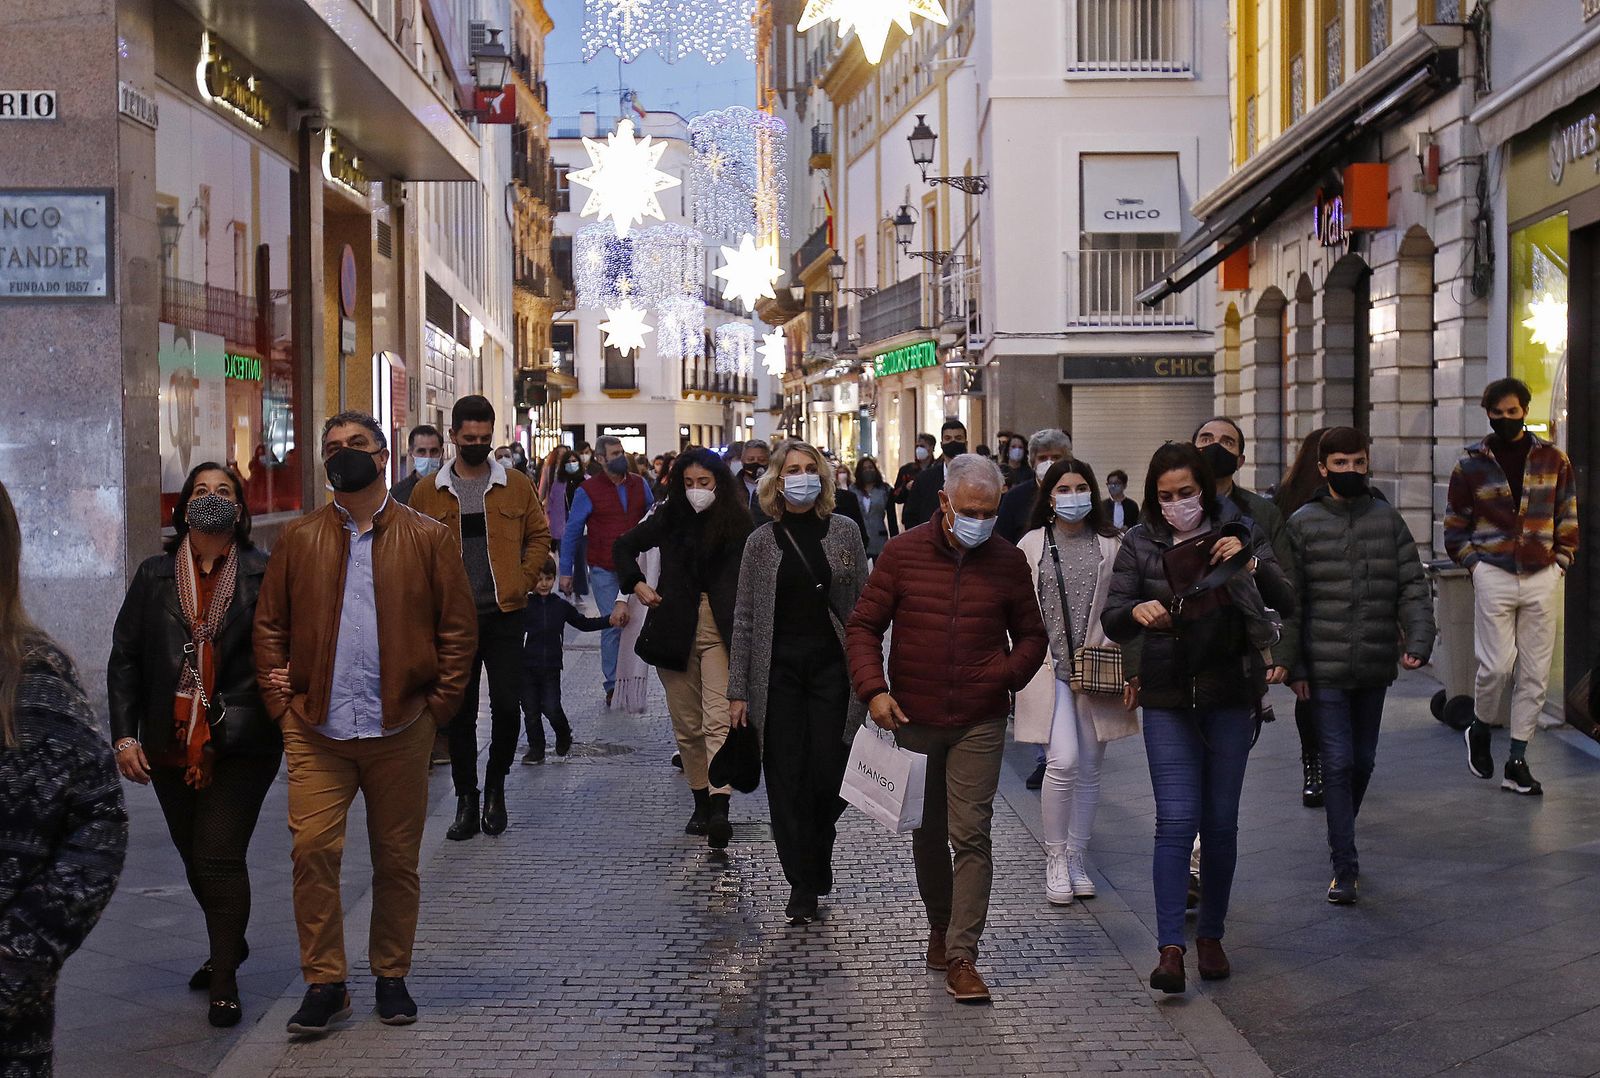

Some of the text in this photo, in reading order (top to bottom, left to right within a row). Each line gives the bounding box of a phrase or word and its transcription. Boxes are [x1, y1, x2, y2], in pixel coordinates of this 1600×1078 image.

[0, 93, 54, 117] RIO
[1562, 112, 1596, 164] YVES
[3, 207, 62, 229] NCO
[1103, 209, 1160, 221] CHICO
[9, 281, 60, 293] FUNDADO
[1154, 357, 1215, 376] CHIC
[857, 760, 895, 792] MANGO
